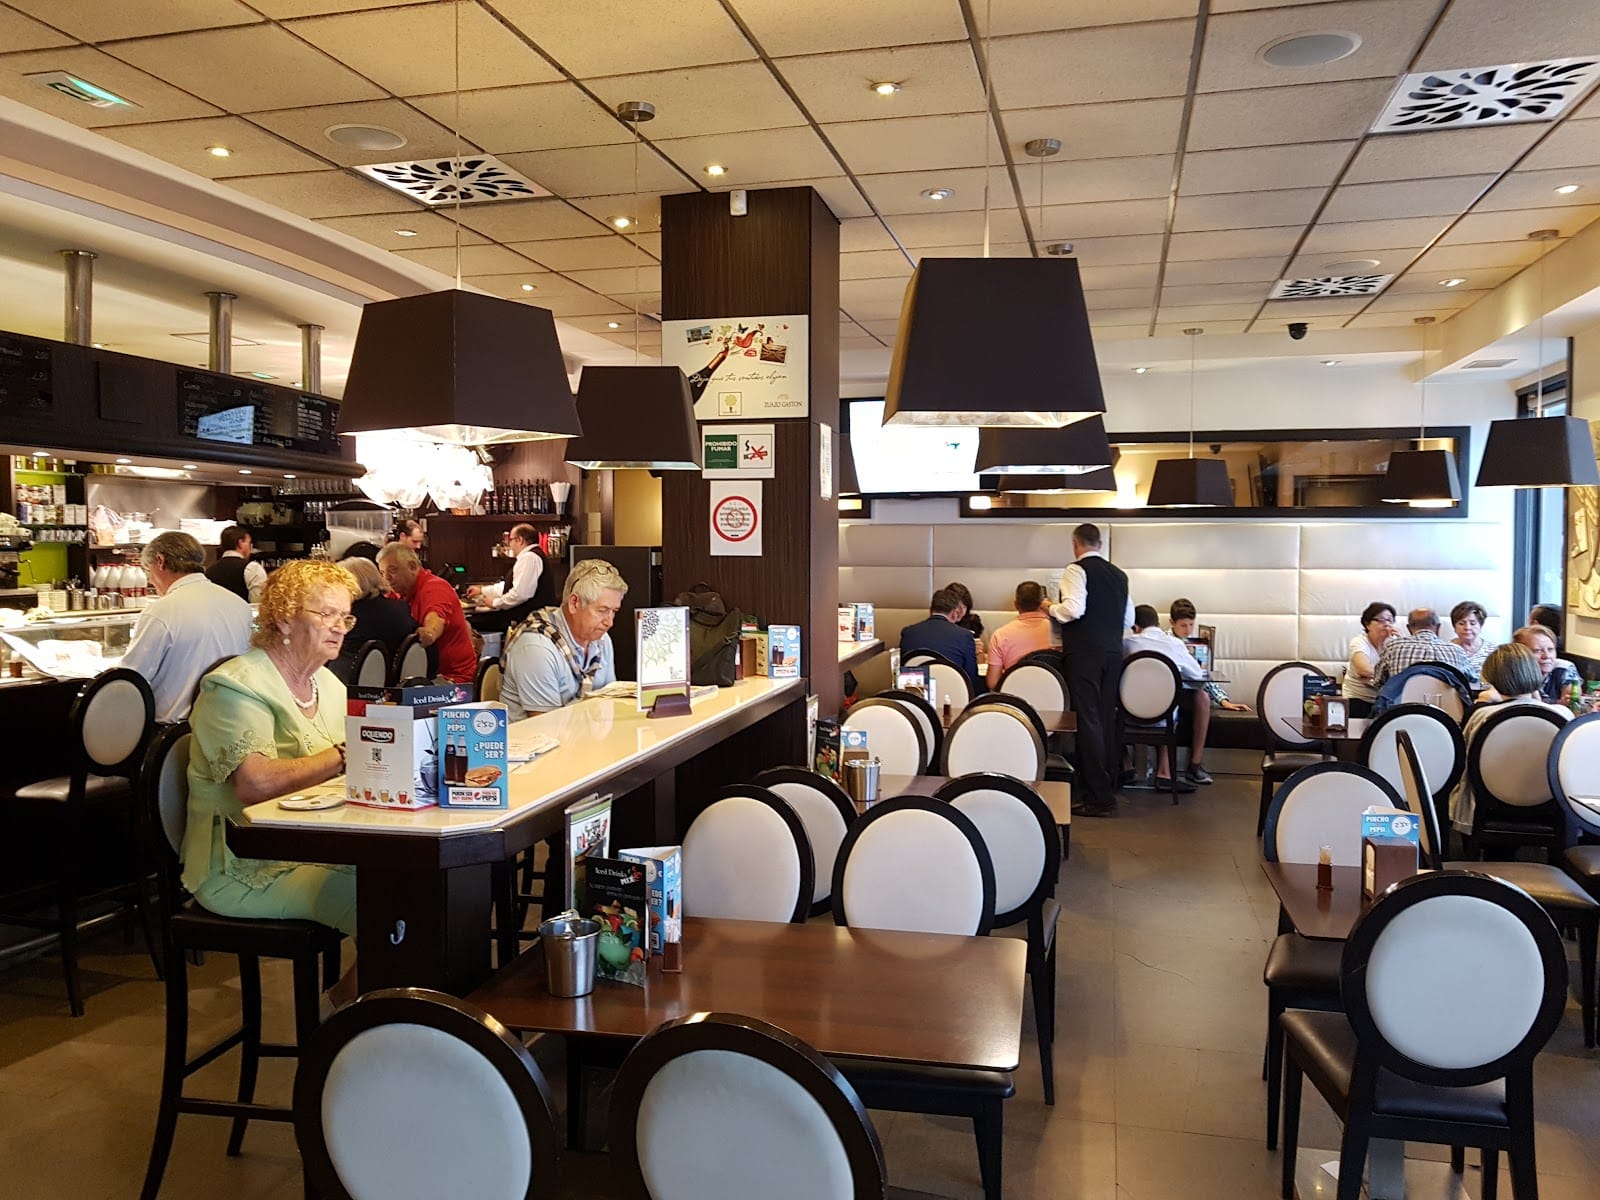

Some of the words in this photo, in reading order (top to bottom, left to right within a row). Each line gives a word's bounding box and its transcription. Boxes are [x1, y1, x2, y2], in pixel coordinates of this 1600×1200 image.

[442, 711, 470, 719] PINCHO
[447, 724, 466, 732] PEPSI
[361, 729, 393, 740] OQUENDO
[474, 742, 504, 752] ¿PUEDE
[595, 867, 607, 876] Iced
[620, 877, 634, 886] MIX
